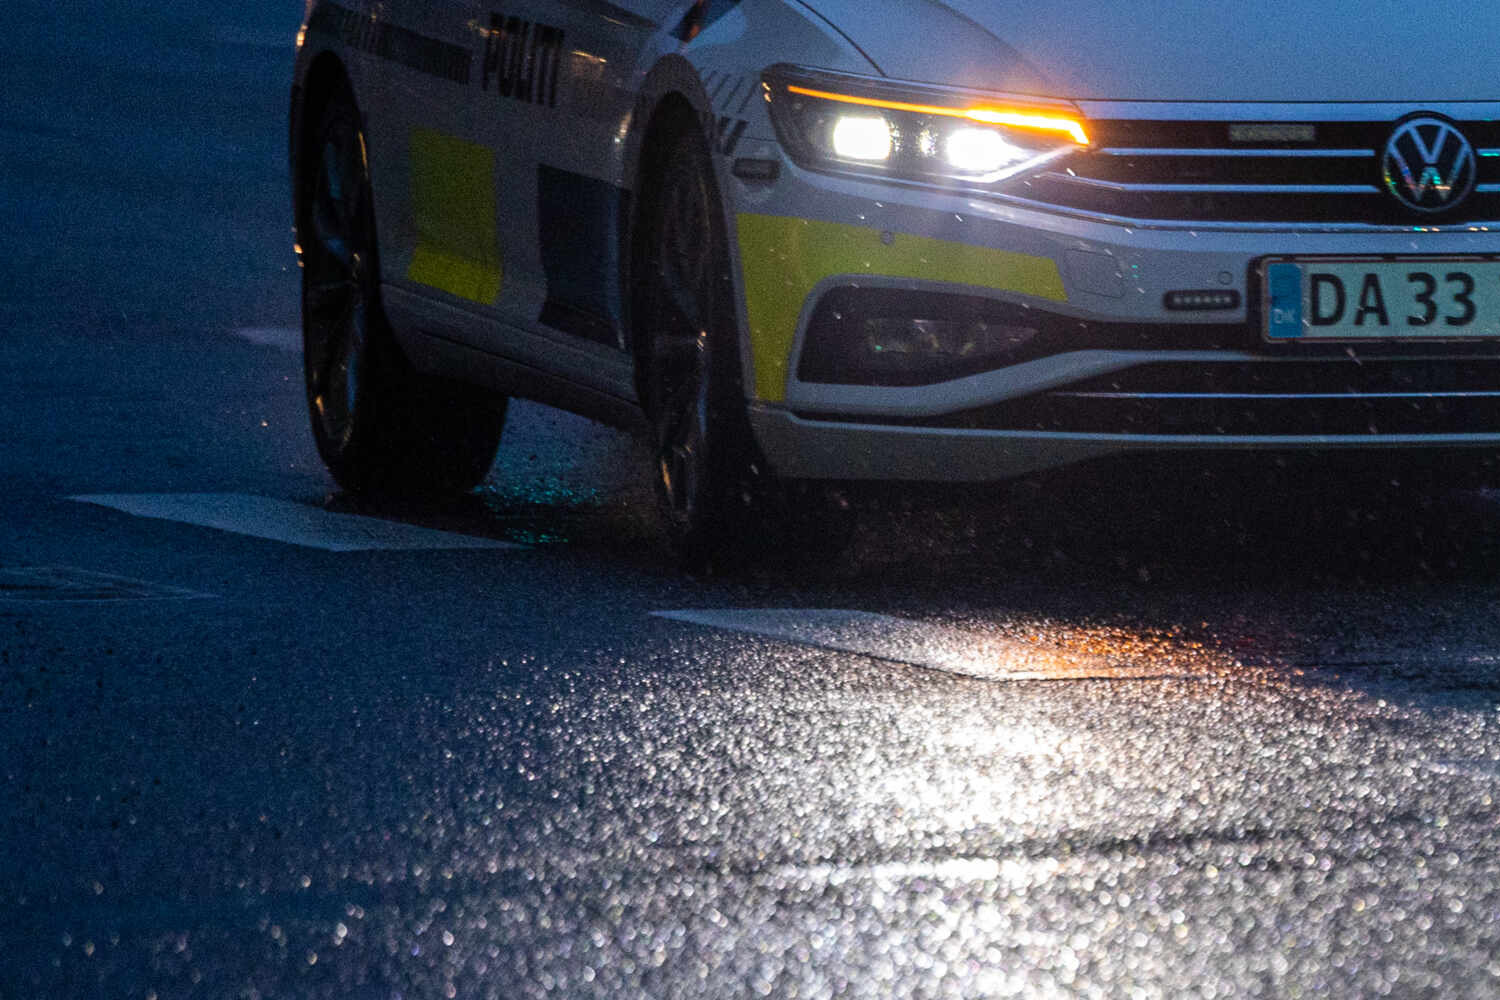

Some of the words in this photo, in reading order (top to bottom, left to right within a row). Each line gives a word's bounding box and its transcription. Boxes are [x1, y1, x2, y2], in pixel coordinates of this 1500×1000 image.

[481, 11, 563, 108] POLITI
[1310, 273, 1389, 326] DA
[1407, 271, 1476, 326] 33
